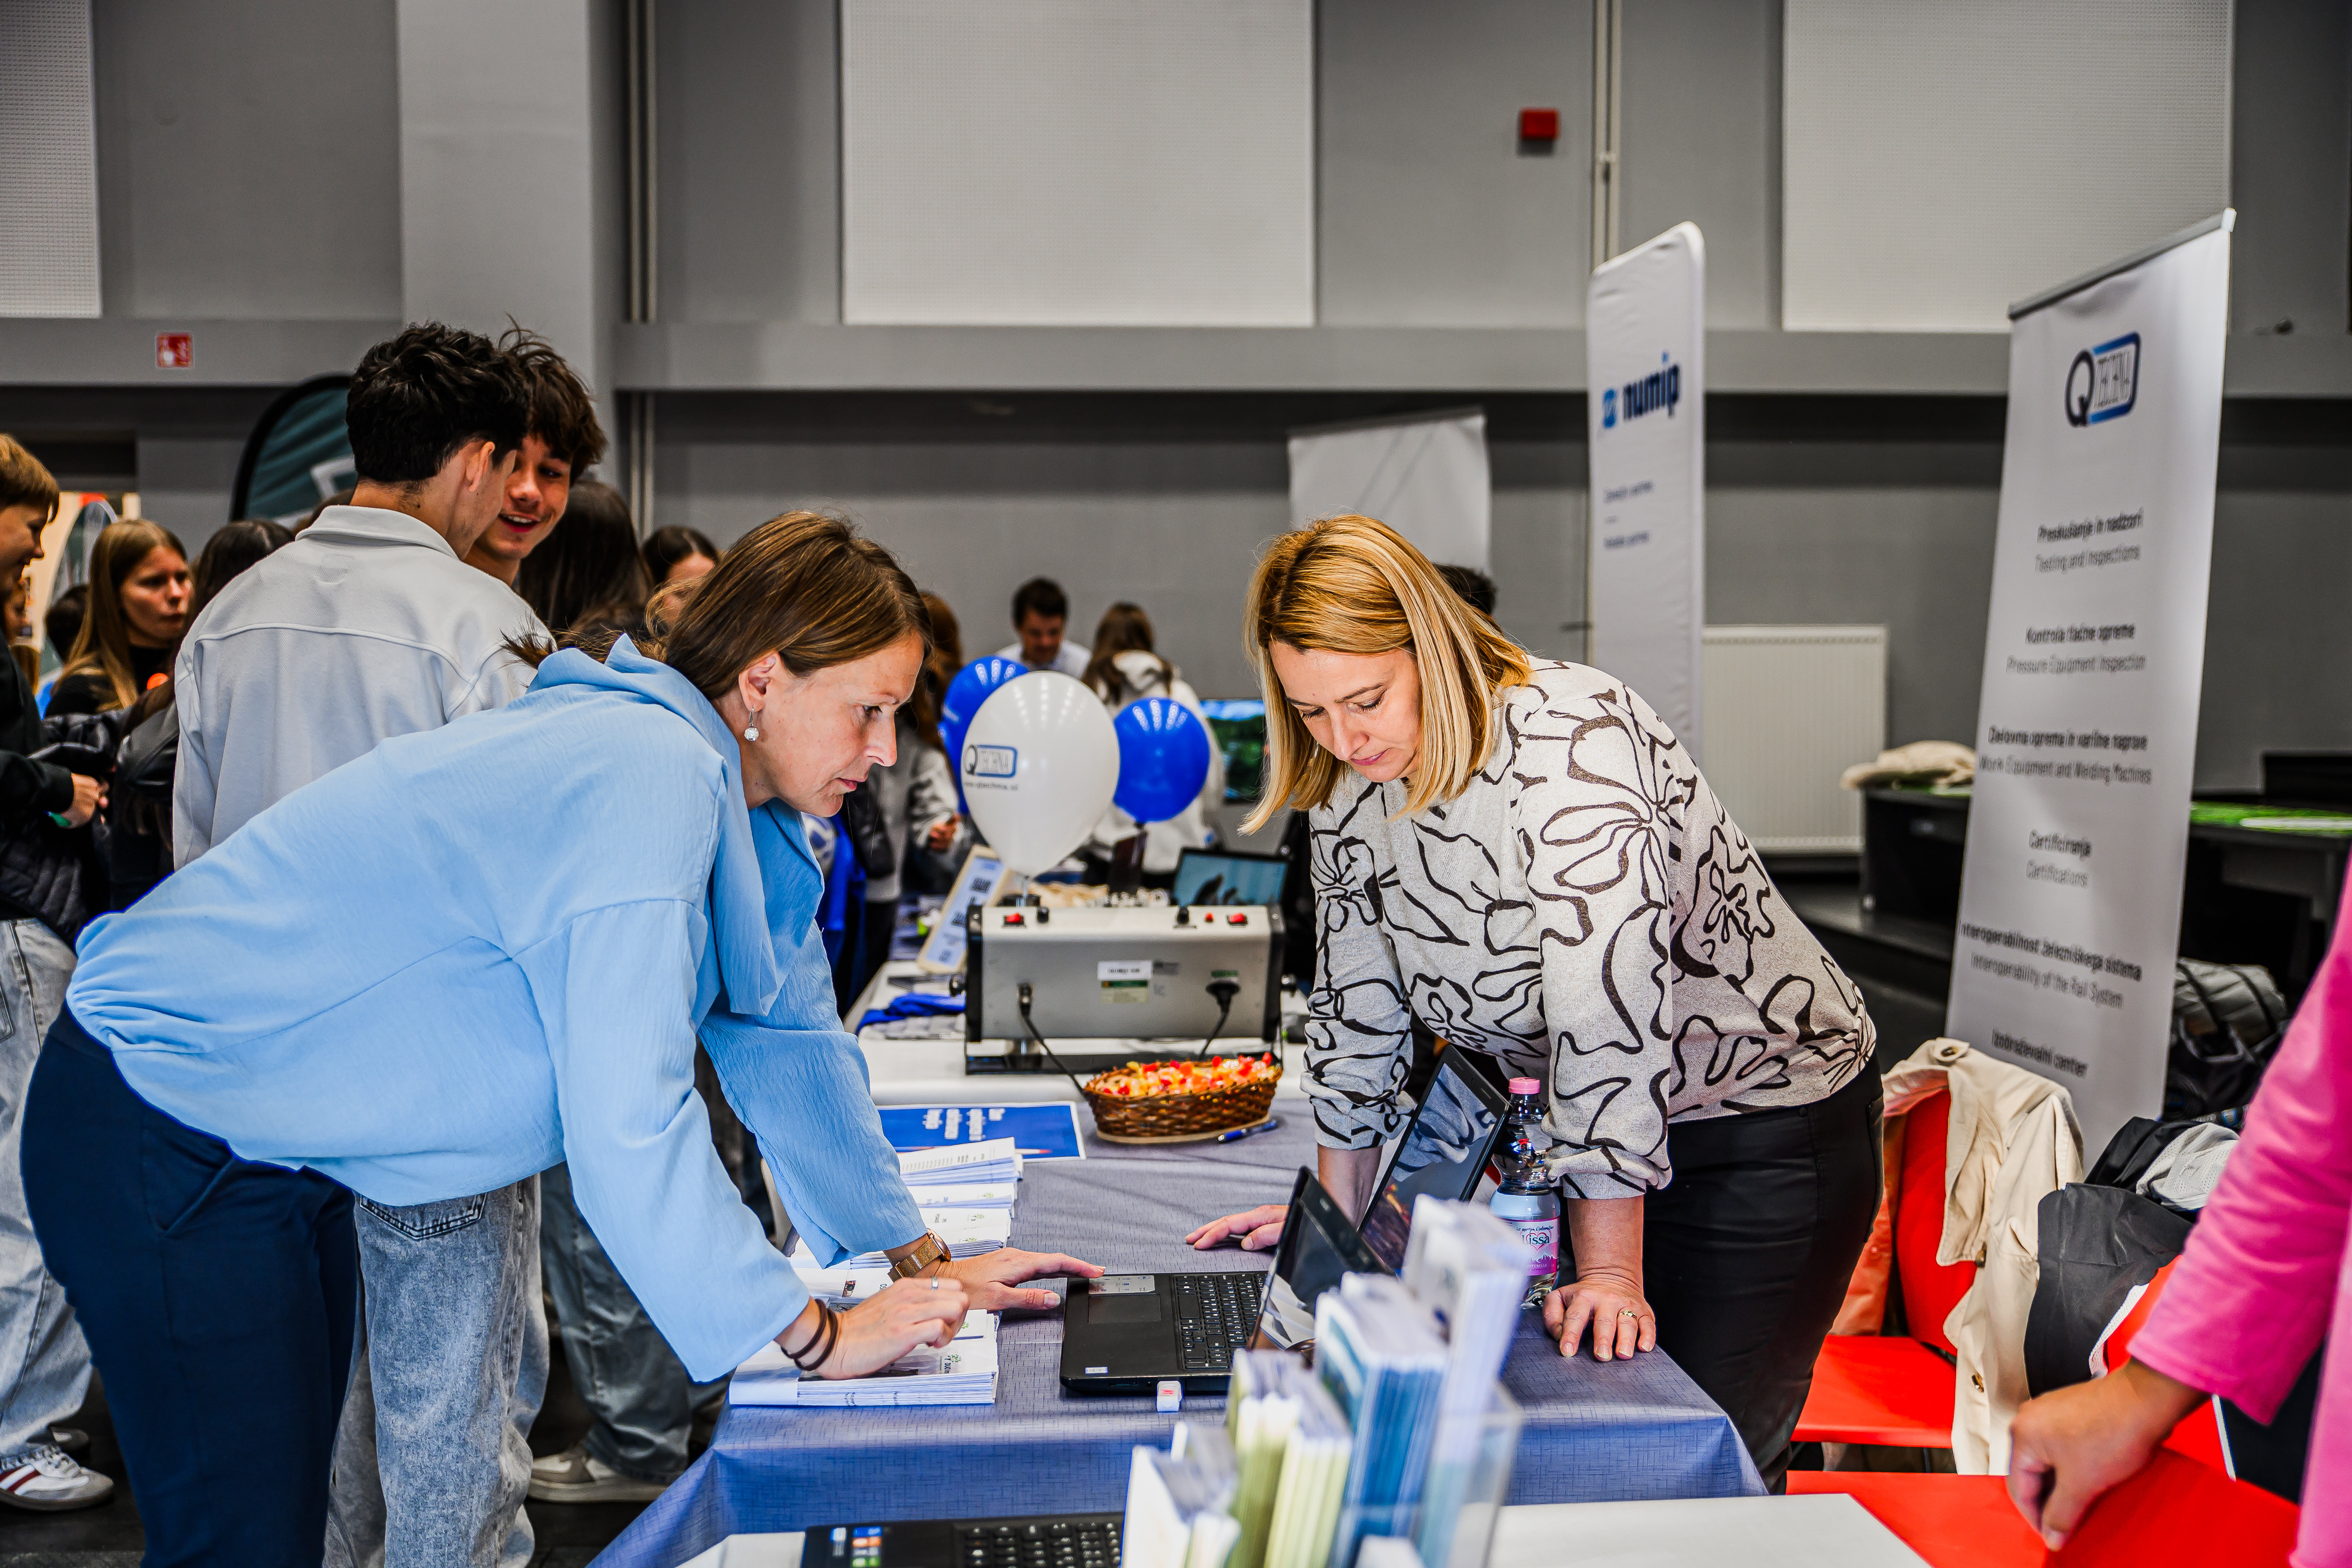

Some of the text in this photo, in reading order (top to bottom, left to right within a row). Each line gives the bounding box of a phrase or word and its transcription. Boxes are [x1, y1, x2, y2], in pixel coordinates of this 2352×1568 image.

[1623, 350, 1680, 420] numip
[2034, 544, 2142, 574] Testing and Inspections
[2025, 624, 2066, 644] Kontrola
[2006, 652, 2147, 676] Pressure Equipment Inspection
[1988, 725, 2028, 745] Delovna
[1979, 754, 2153, 786] Work Equipment and Welding Machines
[2026, 859, 2087, 888] Certifications
[1971, 952, 2124, 1009] Interoperability of the Rail System
[1522, 1235, 1550, 1245] Lissa
